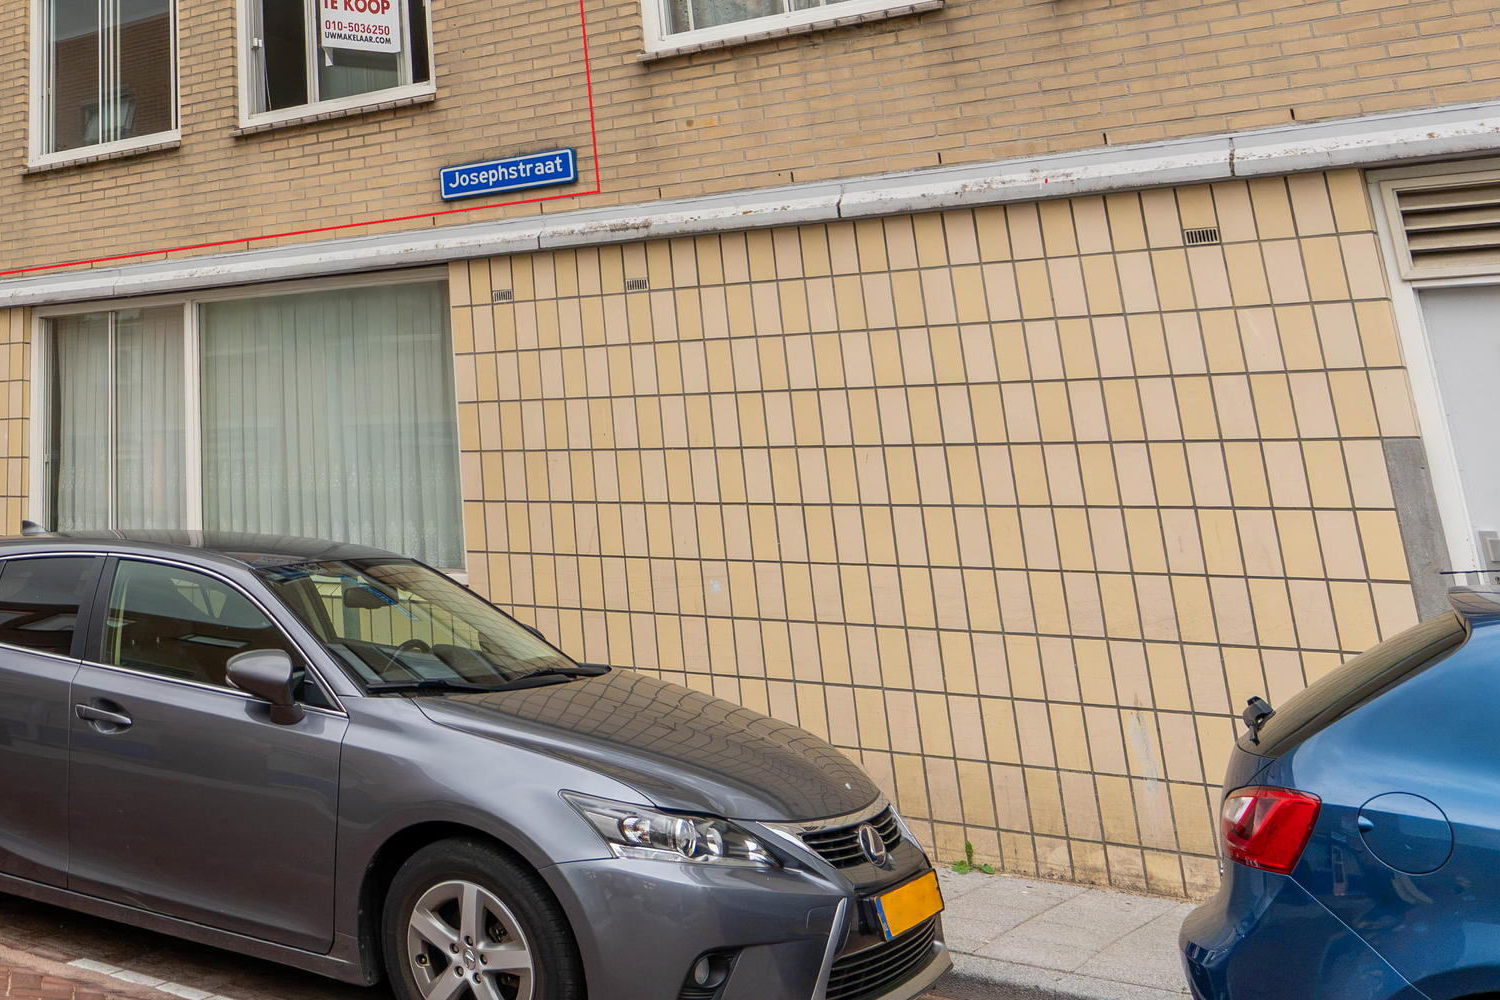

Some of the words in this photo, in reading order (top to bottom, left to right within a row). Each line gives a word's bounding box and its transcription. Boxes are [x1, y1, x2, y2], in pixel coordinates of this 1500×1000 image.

[325, 20, 390, 35] 010-5036250
[324, 31, 391, 45] UWMAKELAAR.COM
[449, 156, 563, 188] Josephstraat
